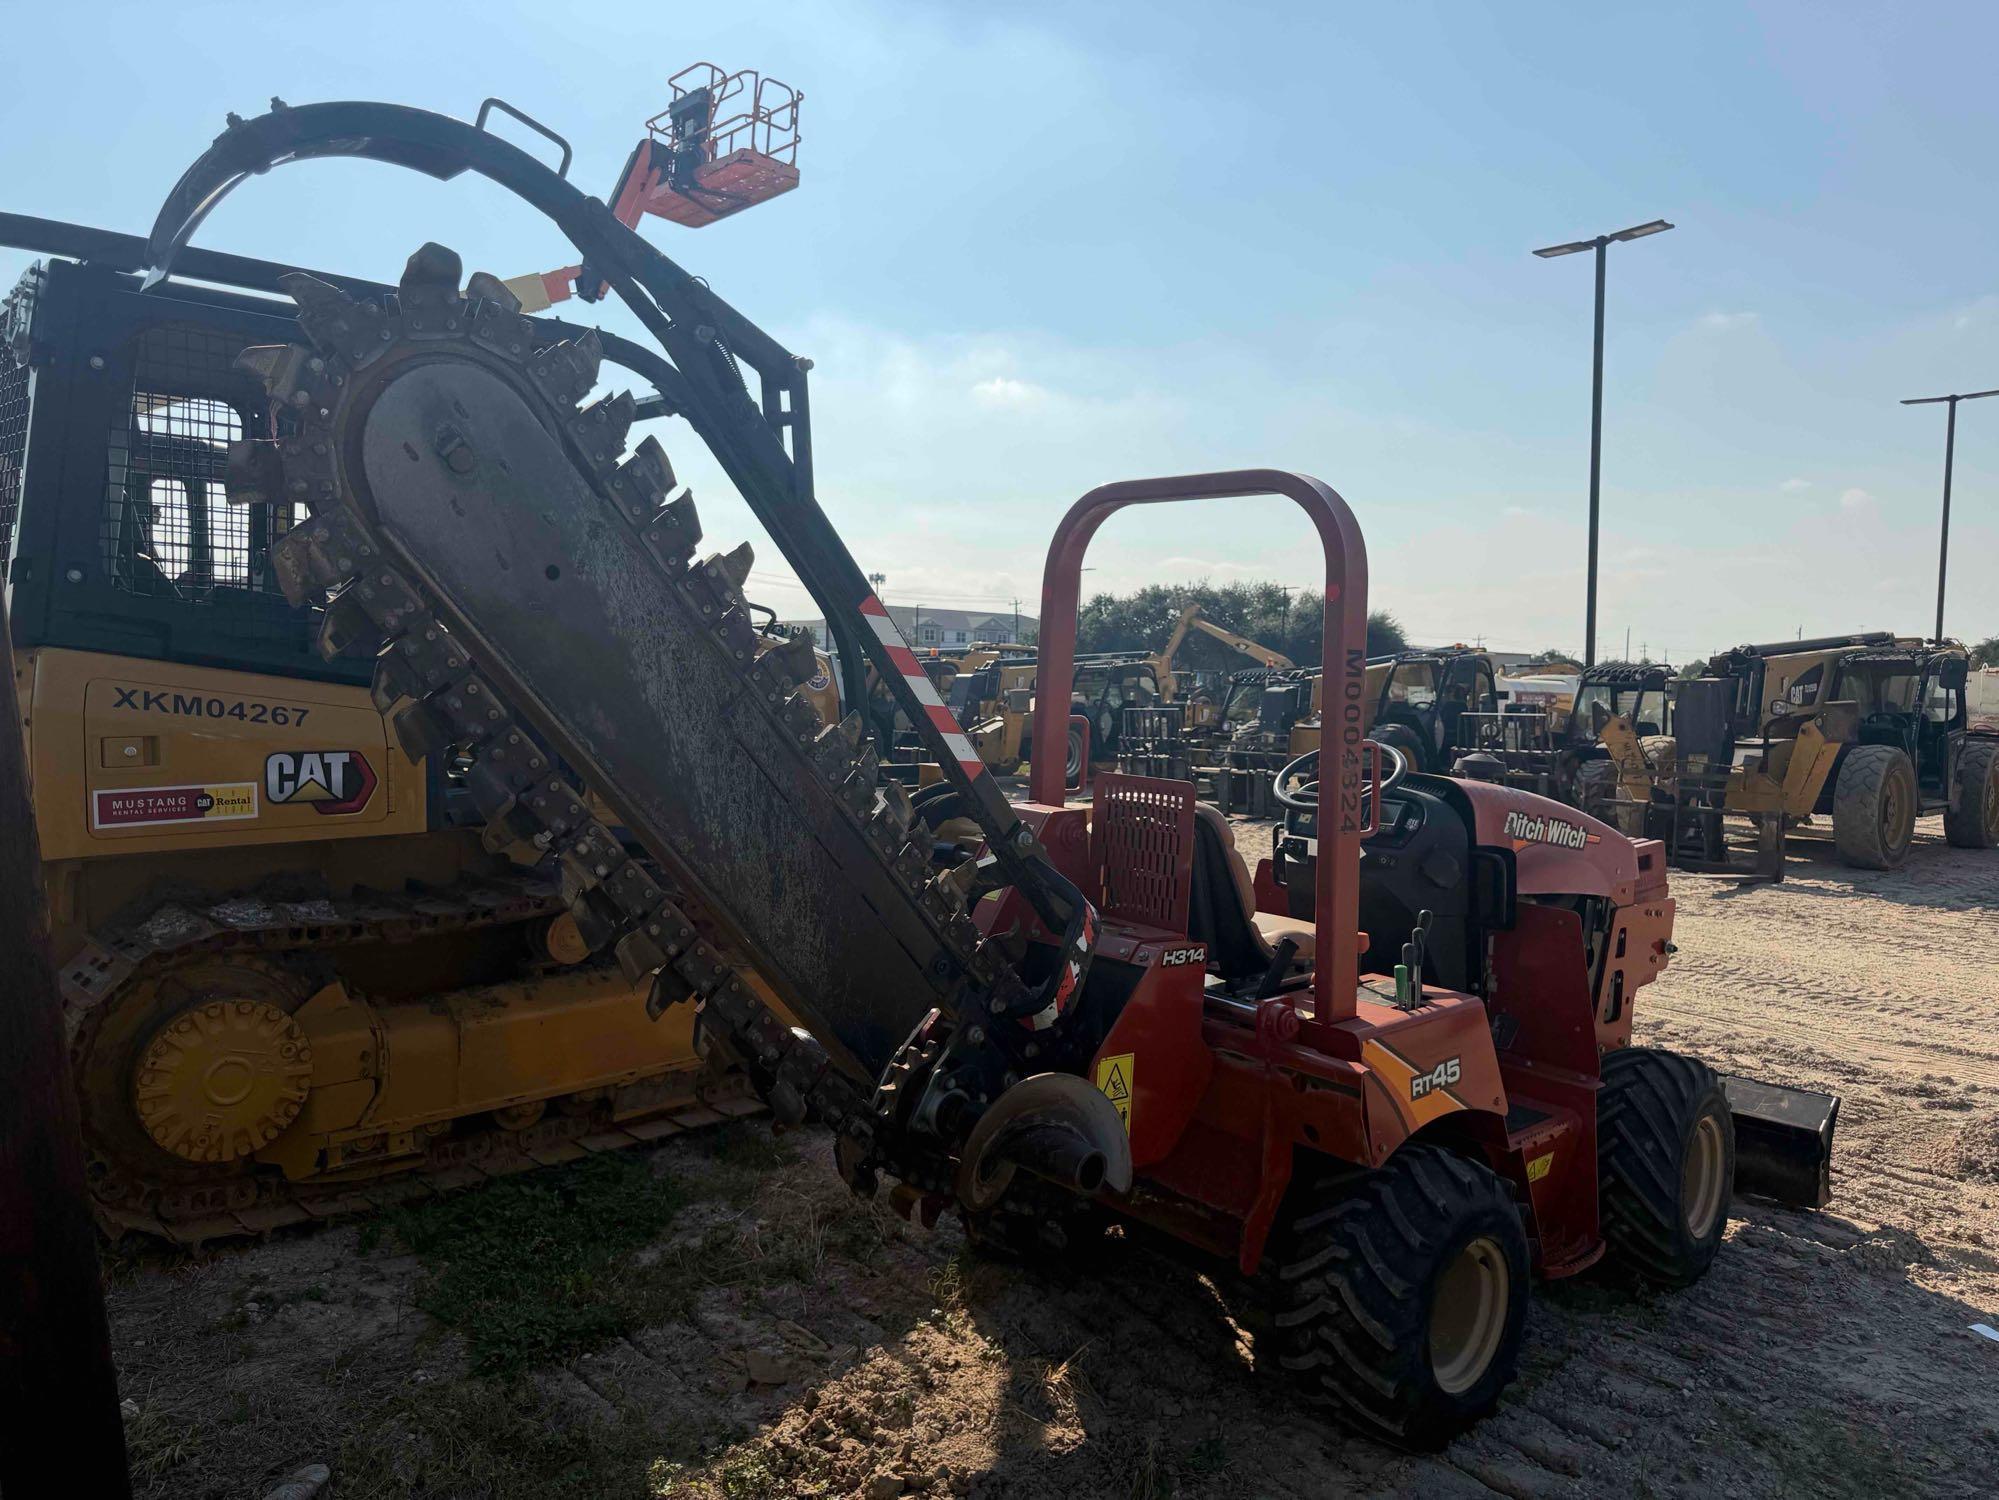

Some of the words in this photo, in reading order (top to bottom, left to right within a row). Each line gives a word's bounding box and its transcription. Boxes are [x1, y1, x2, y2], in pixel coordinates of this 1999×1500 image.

[1790, 685, 1804, 704] CAT
[113, 686, 310, 728] XKM04267
[266, 751, 351, 804] CAT
[112, 796, 188, 811] MUSTANG
[112, 808, 145, 817] RENTAL
[147, 806, 188, 815] SERVICES
[197, 798, 212, 808] CAT
[215, 796, 252, 807] Rental
[1503, 811, 1545, 841] Ditch
[1546, 818, 1587, 849] Witch
[1162, 947, 1205, 967] H314
[1411, 1057, 1462, 1098] RT45
